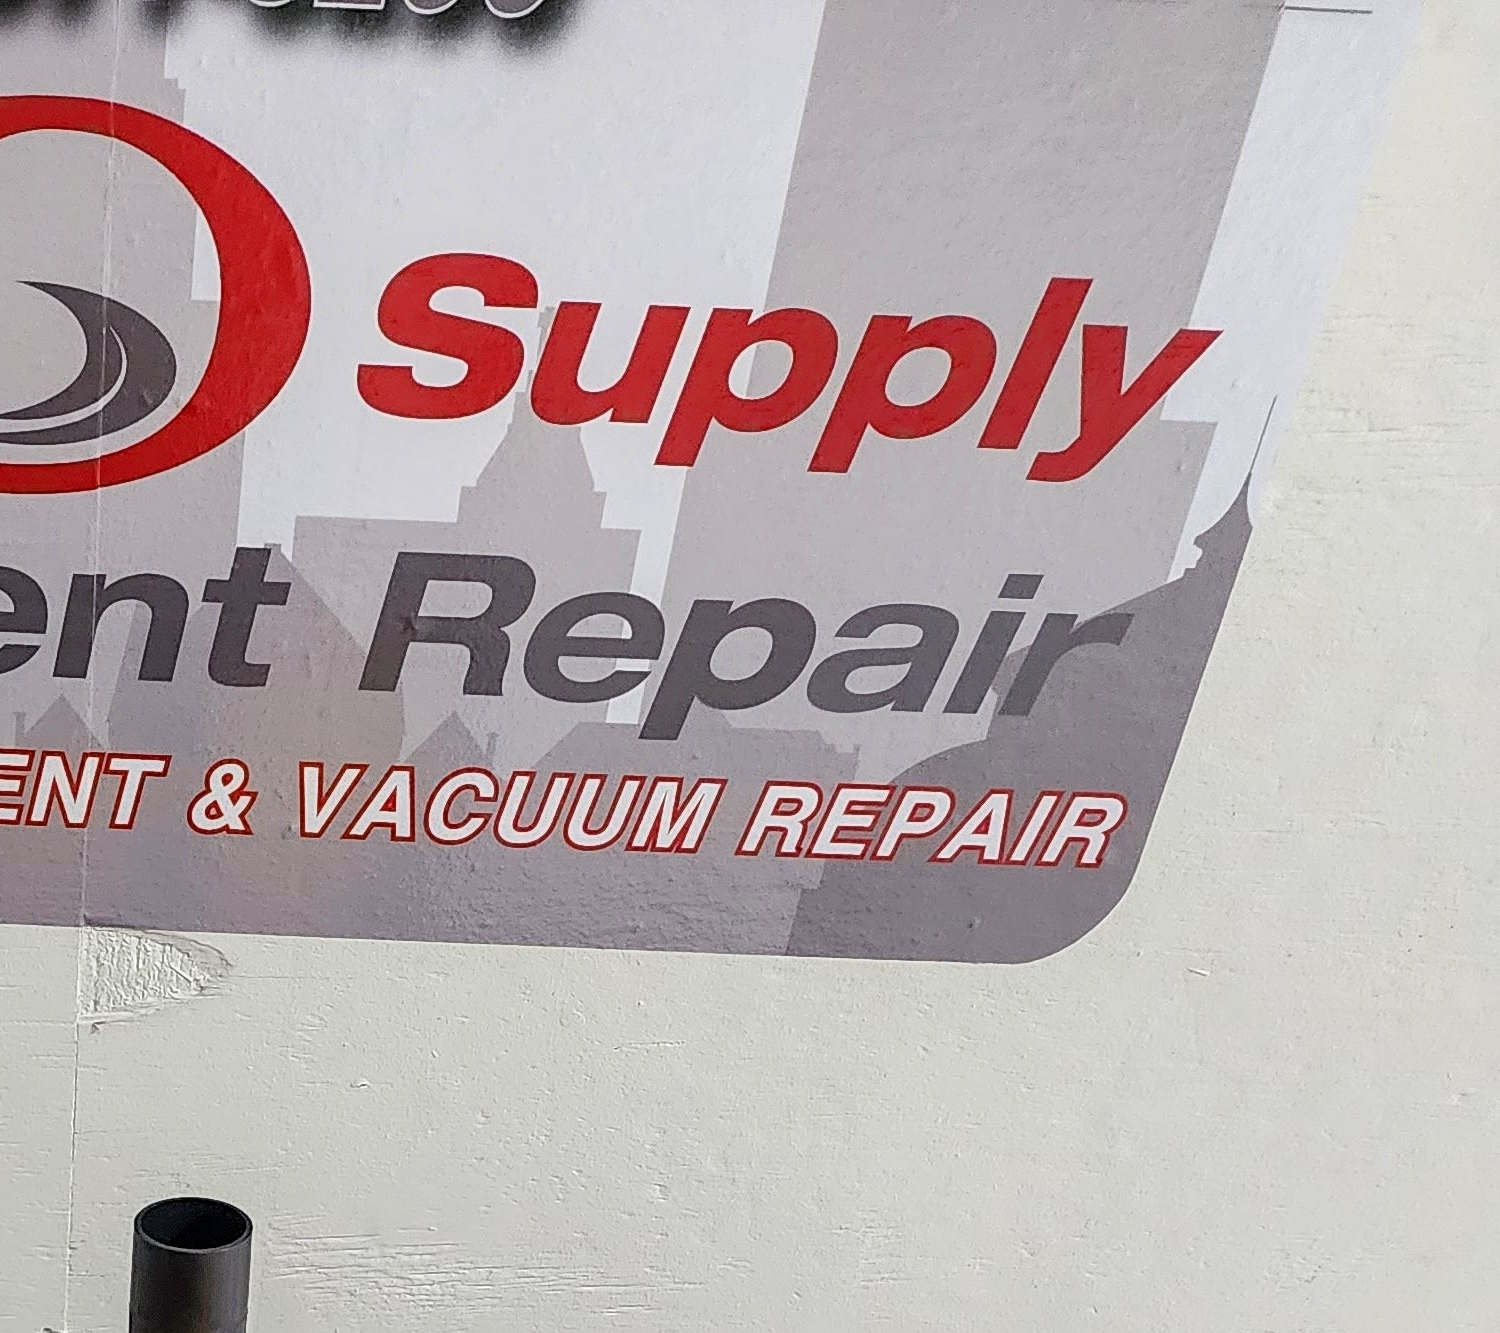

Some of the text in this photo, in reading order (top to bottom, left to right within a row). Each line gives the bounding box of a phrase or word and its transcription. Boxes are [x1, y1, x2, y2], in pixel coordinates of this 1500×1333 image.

[356, 252, 1223, 482] Supply
[358, 551, 1133, 740] Repair
[186, 758, 257, 837] &
[299, 761, 728, 854] VACUUM
[736, 779, 1126, 868] REPAIR
